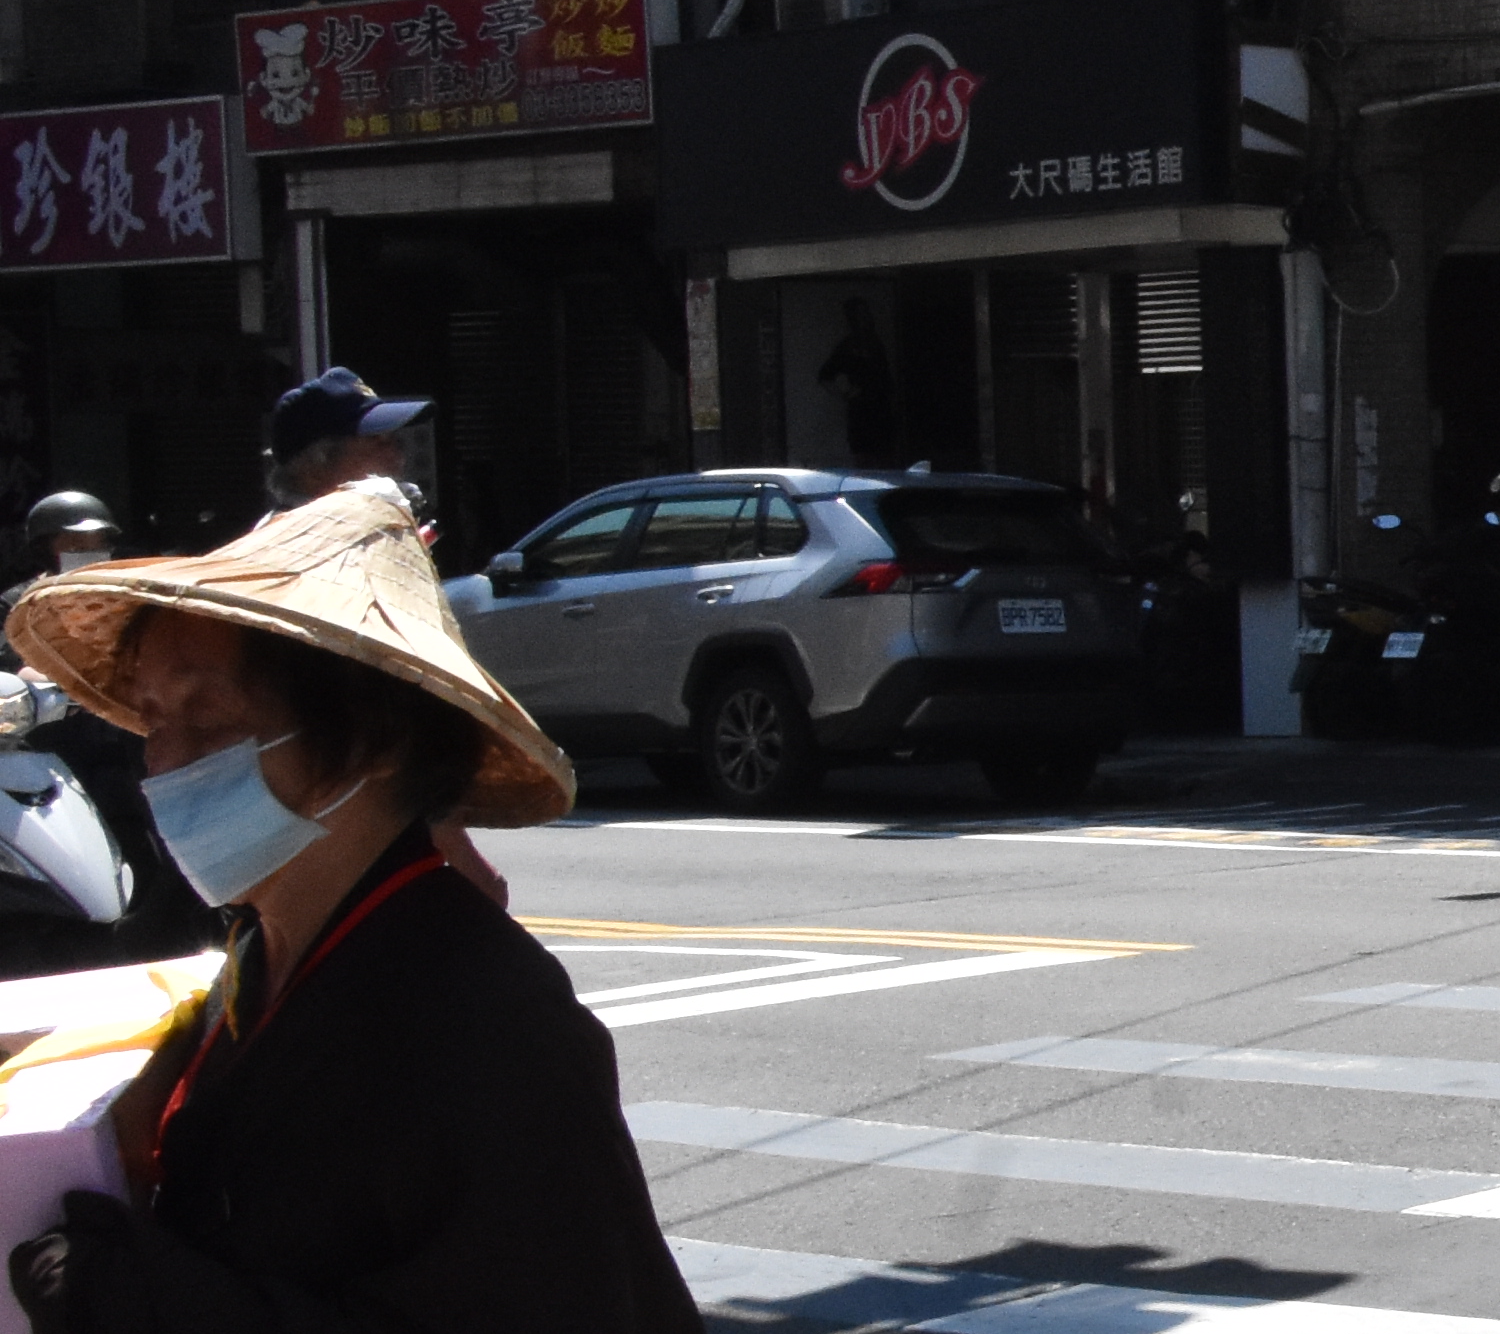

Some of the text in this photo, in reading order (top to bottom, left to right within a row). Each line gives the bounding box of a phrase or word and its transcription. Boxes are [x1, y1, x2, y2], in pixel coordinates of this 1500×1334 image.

[0, 117, 215, 255] 珍銀樓
[1009, 145, 1184, 201] 大尺碼生活館
